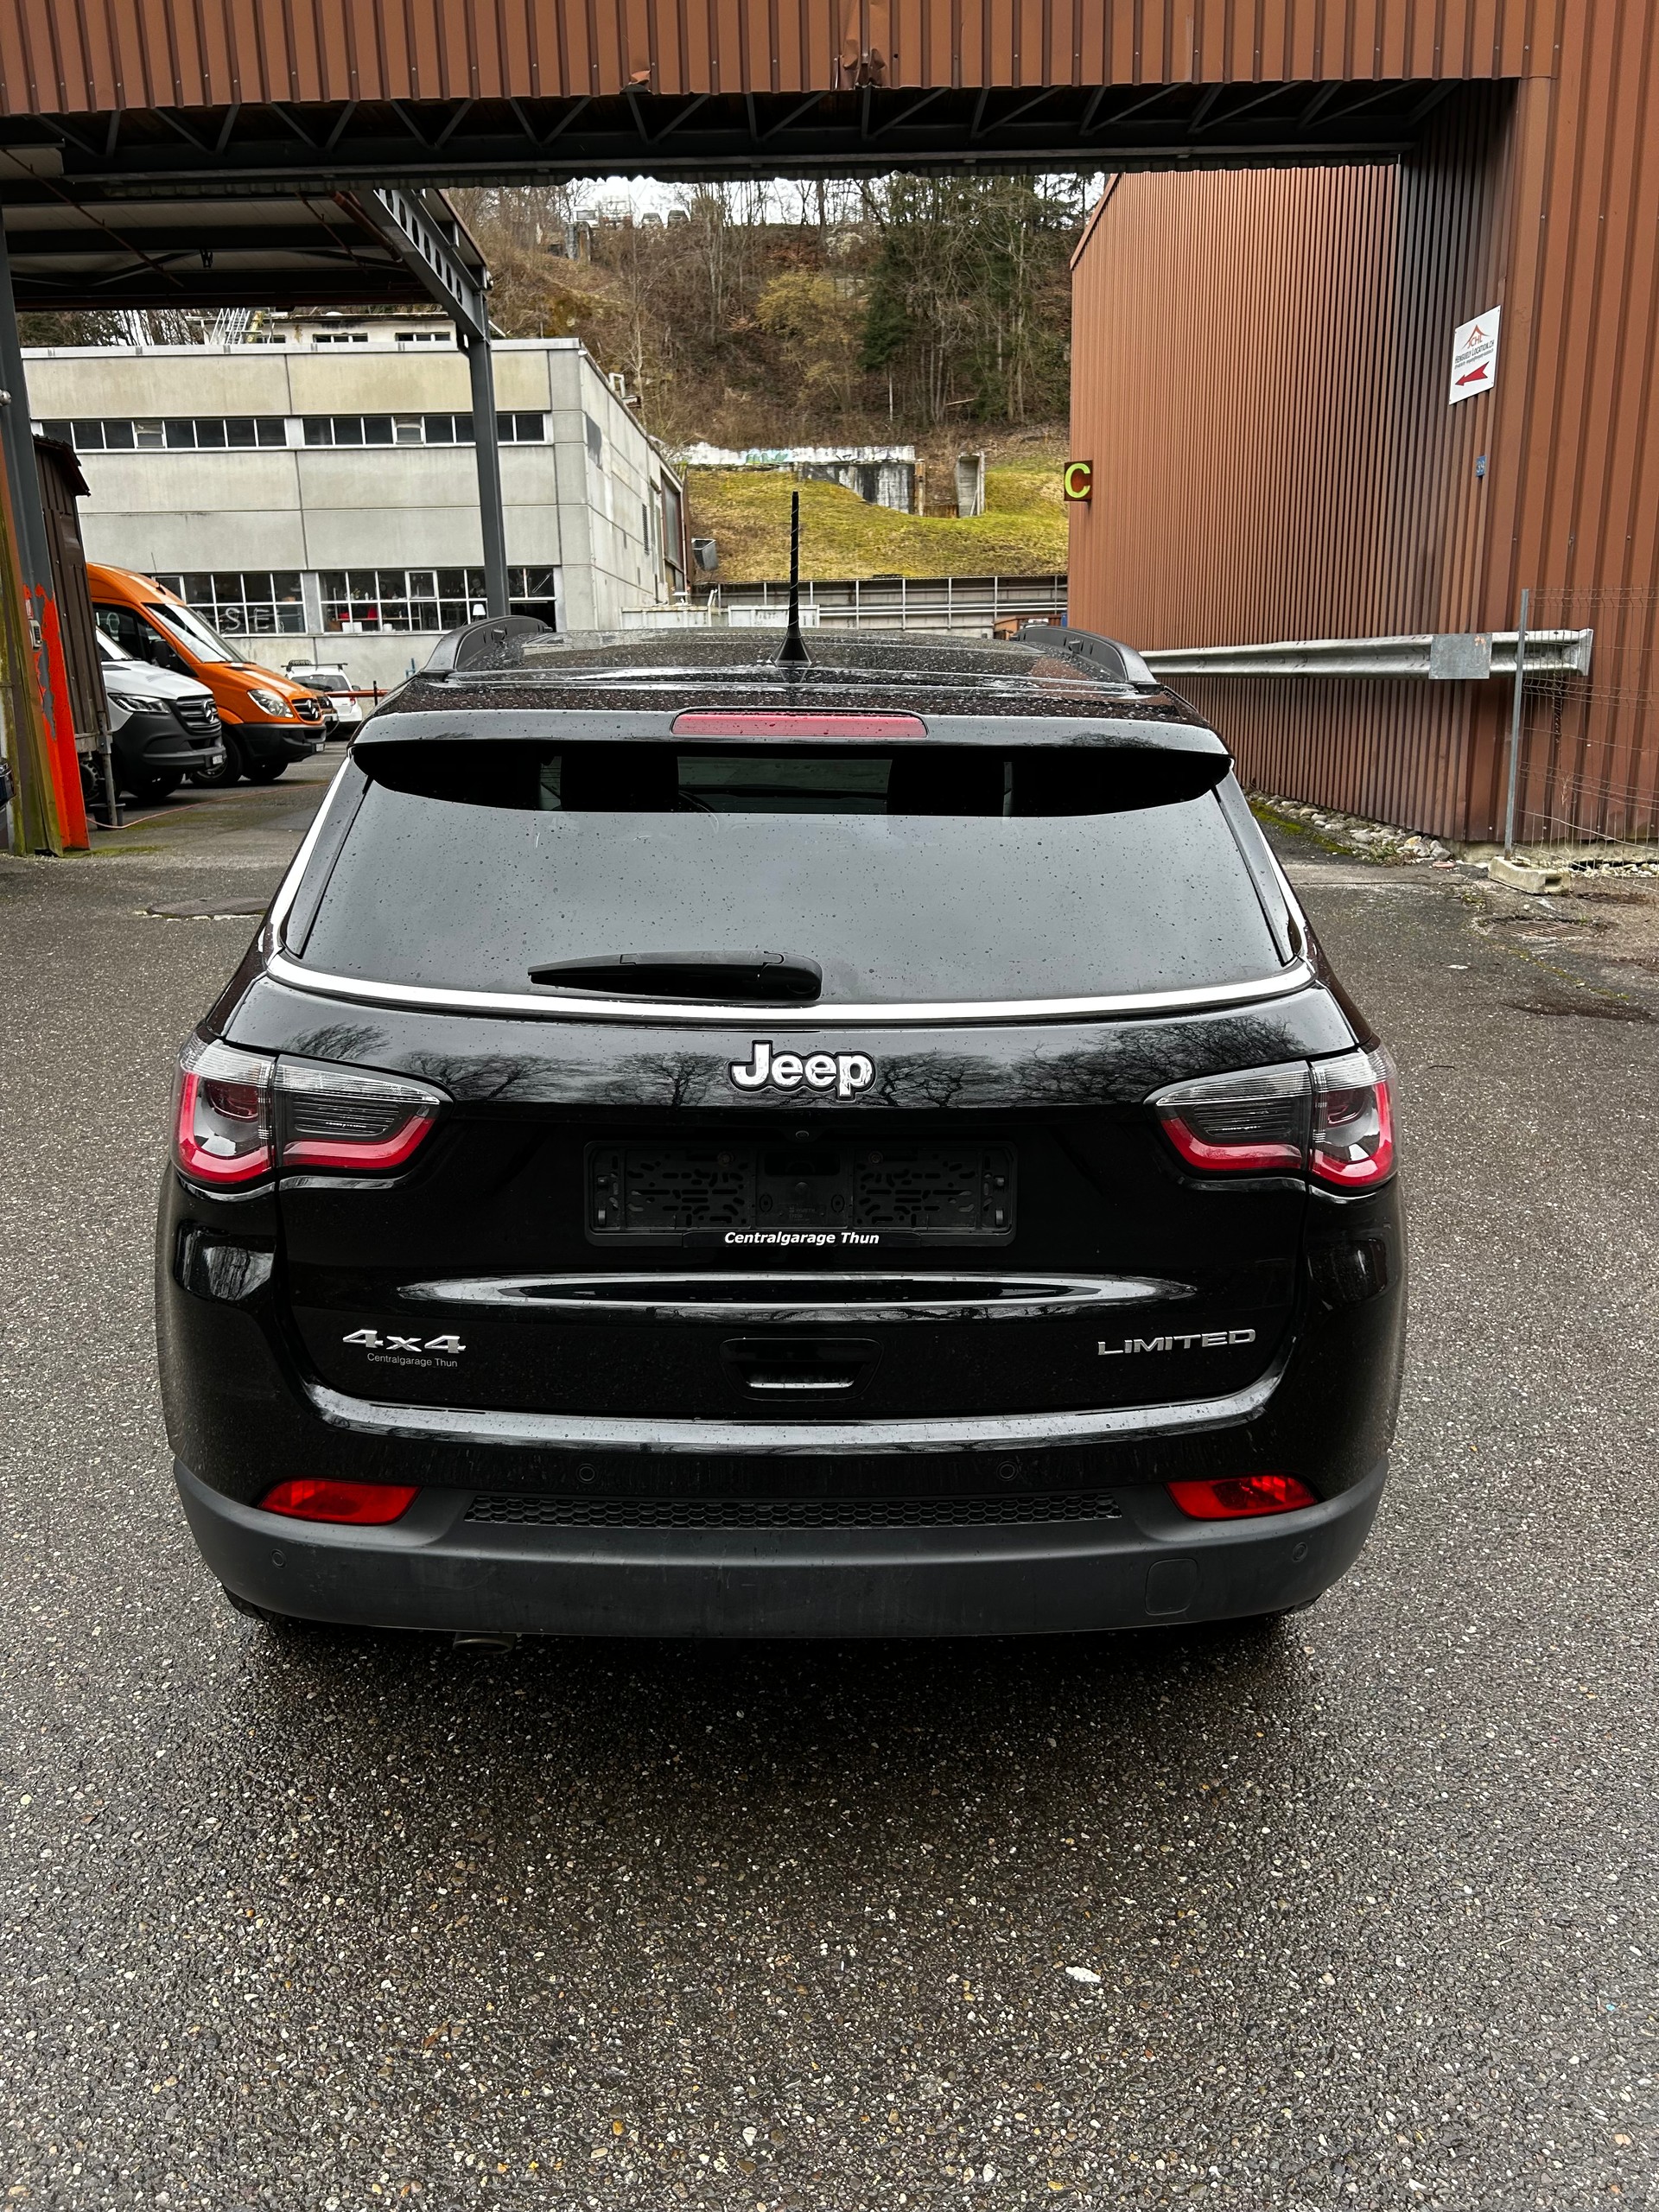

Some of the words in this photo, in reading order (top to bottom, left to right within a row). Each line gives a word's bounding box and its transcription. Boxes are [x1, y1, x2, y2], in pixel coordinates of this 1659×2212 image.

[1065, 462, 1091, 499] C
[731, 1041, 874, 1098] Jeep
[724, 1231, 836, 1246] Centralgarage
[841, 1232, 880, 1244] Thun
[342, 1329, 467, 1354] 4x4
[1097, 1328, 1256, 1356] LIMITED
[366, 1352, 433, 1367] Centralgarage
[434, 1357, 458, 1368] Thun
